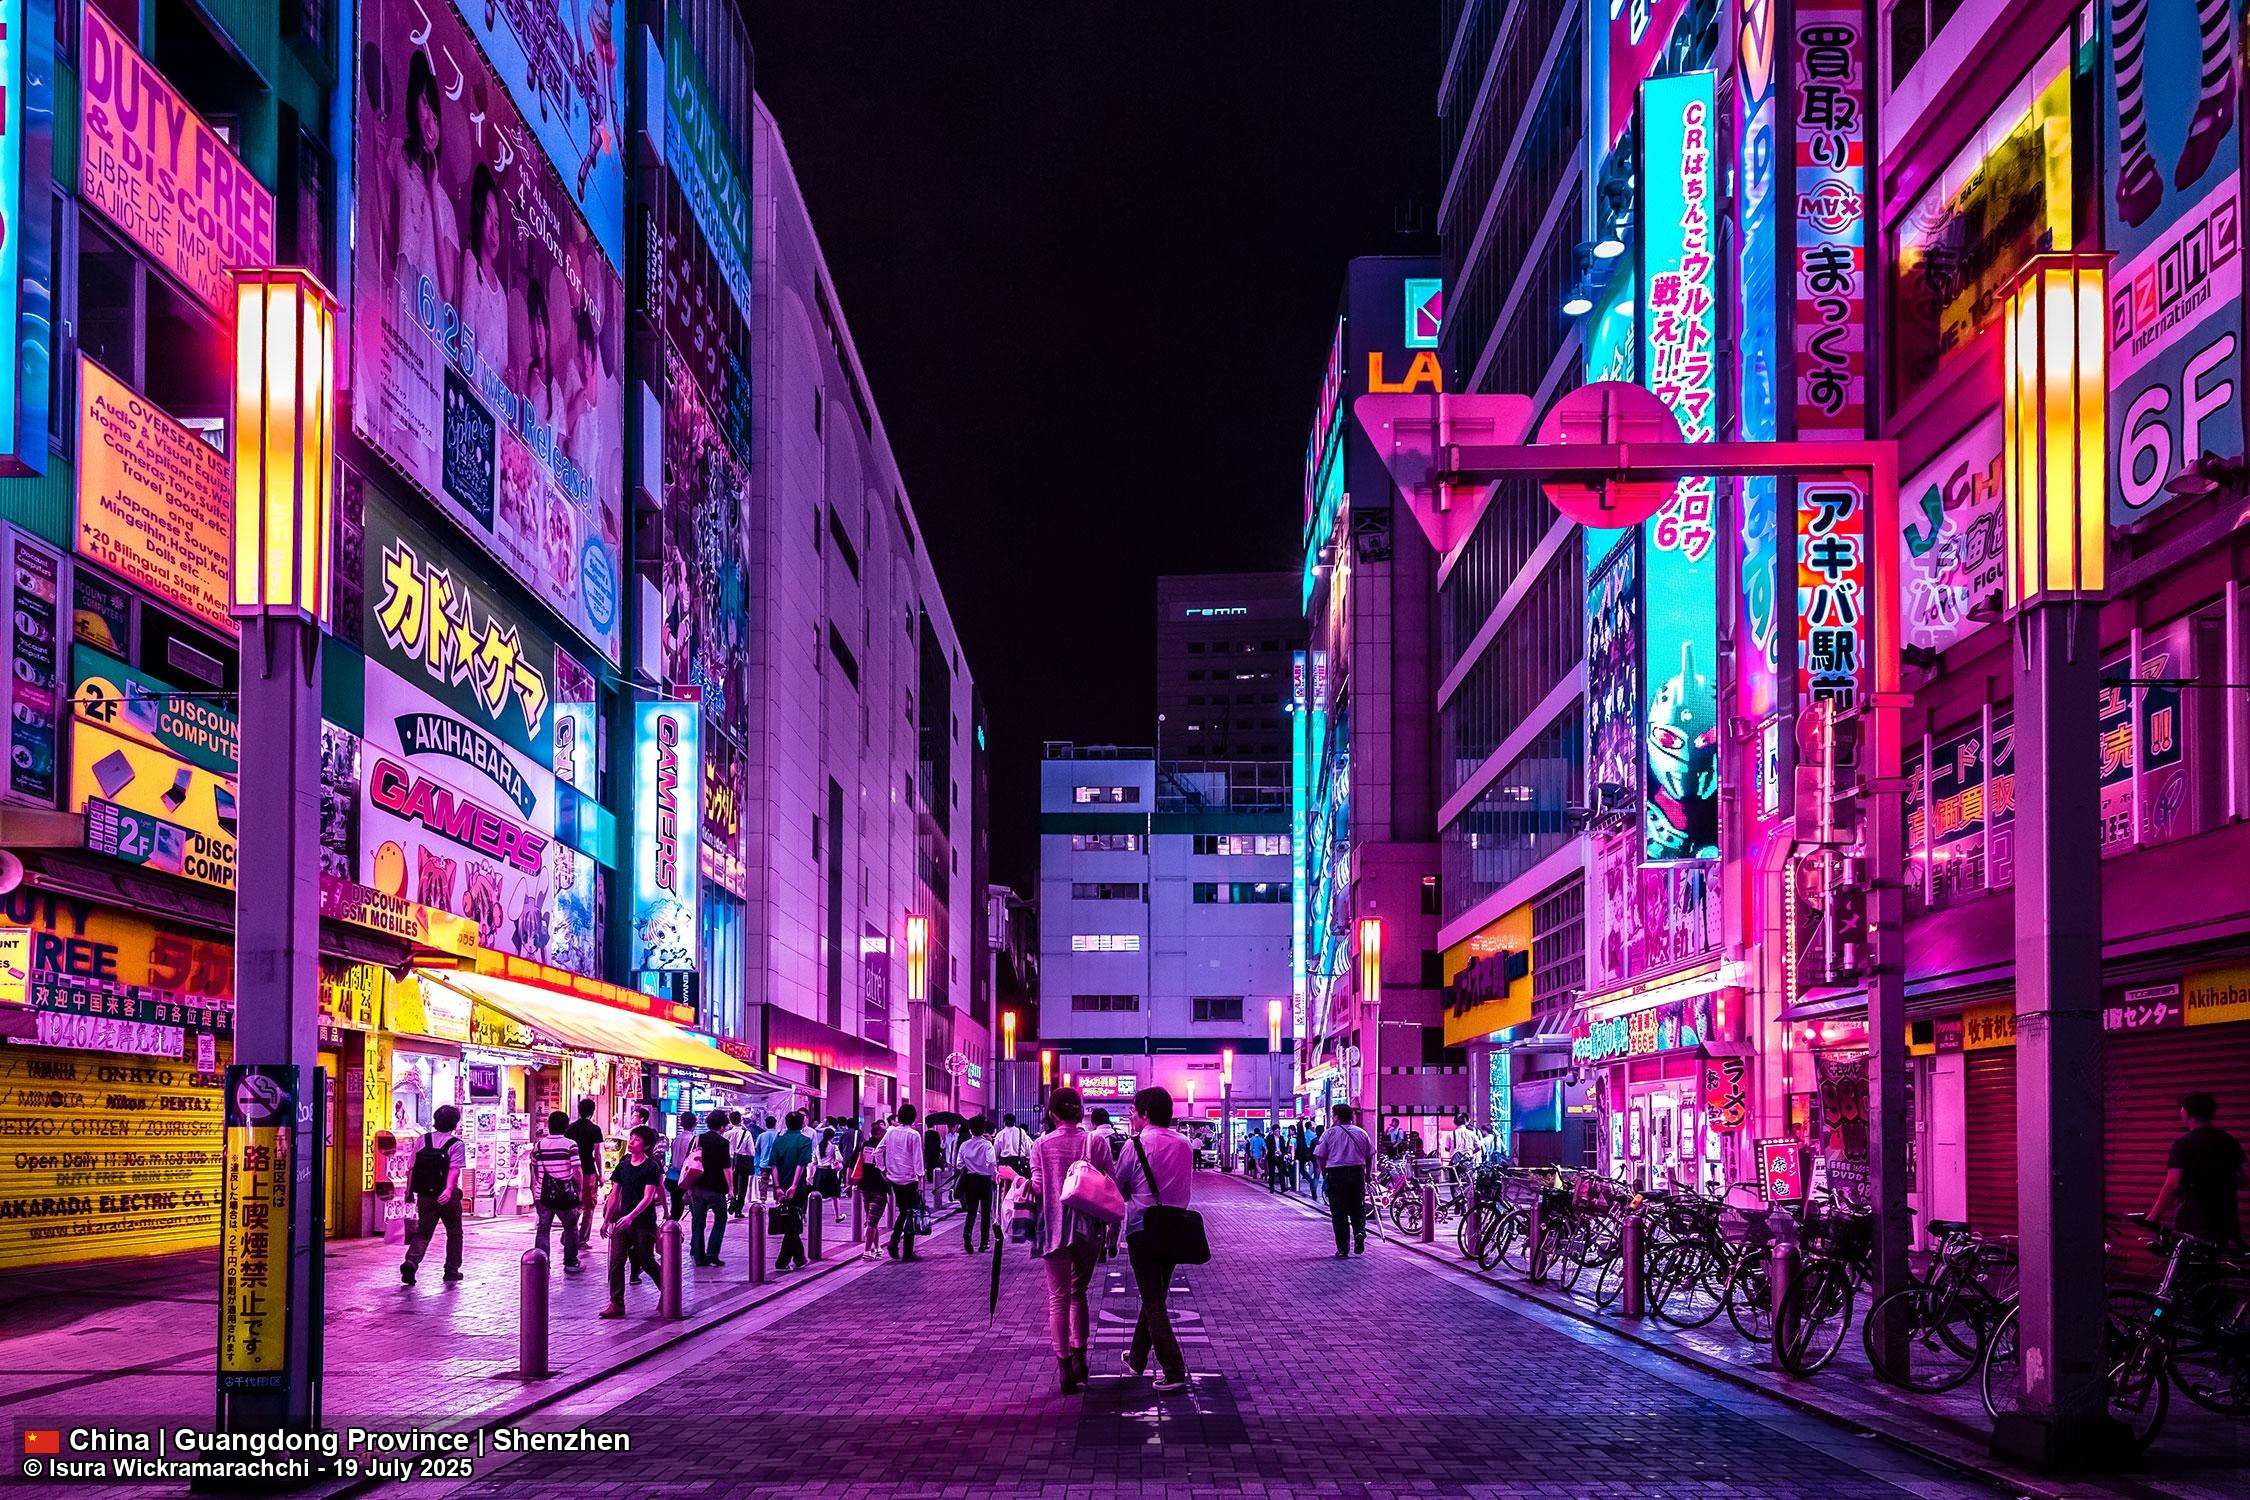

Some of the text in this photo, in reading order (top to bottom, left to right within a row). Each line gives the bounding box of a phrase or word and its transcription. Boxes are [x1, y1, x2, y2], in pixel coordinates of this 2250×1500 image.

[1801, 26, 1858, 171] 買取り
[87, 104, 114, 147] &
[87, 15, 272, 257] DUTY FREE
[85, 135, 141, 210] LIBRE
[148, 199, 172, 237] DE
[533, 185, 561, 236] ALBUM
[517, 183, 602, 327] 4 colors for you
[2112, 193, 2239, 353] azone
[1804, 245, 1855, 415] まっくす
[2131, 279, 2212, 357] International
[418, 273, 475, 378] 6.25
[522, 394, 593, 515] Release!
[90, 407, 132, 442] Home
[129, 400, 204, 462] OVERSEAS
[2118, 331, 2238, 509] 6F
[95, 395, 231, 497] Audio & Visual Equip
[122, 461, 162, 499] Travel
[115, 489, 181, 538] Japanese
[169, 509, 193, 532] and
[114, 536, 170, 583] Bilingual
[173, 573, 200, 600] Staff
[146, 538, 177, 567] Dolls
[120, 557, 193, 609] Languages
[1187, 606, 1248, 617] remm
[86, 684, 117, 724] 2F
[415, 716, 523, 797] AKIHABARA
[370, 757, 550, 876] GAMERS
[656, 714, 679, 896] GAMERS
[119, 816, 149, 858] 2F
[341, 901, 418, 938] GSM MOBILES
[352, 884, 410, 917] DISCOUNT
[98, 1066, 173, 1087] ONKYO
[1723, 1059, 1747, 1128] ラーメン
[71, 1118, 130, 1136] CITIZEN
[160, 1095, 212, 1112] PENTAX
[15, 1152, 98, 1173] Open Daily
[1787, 1147, 1797, 1177] ラーメン
[99, 1190, 178, 1214] ELECTRIC
[240, 1145, 271, 1365] 路上喫煙禁止です。
[234, 1375, 282, 1388] 千代田区
